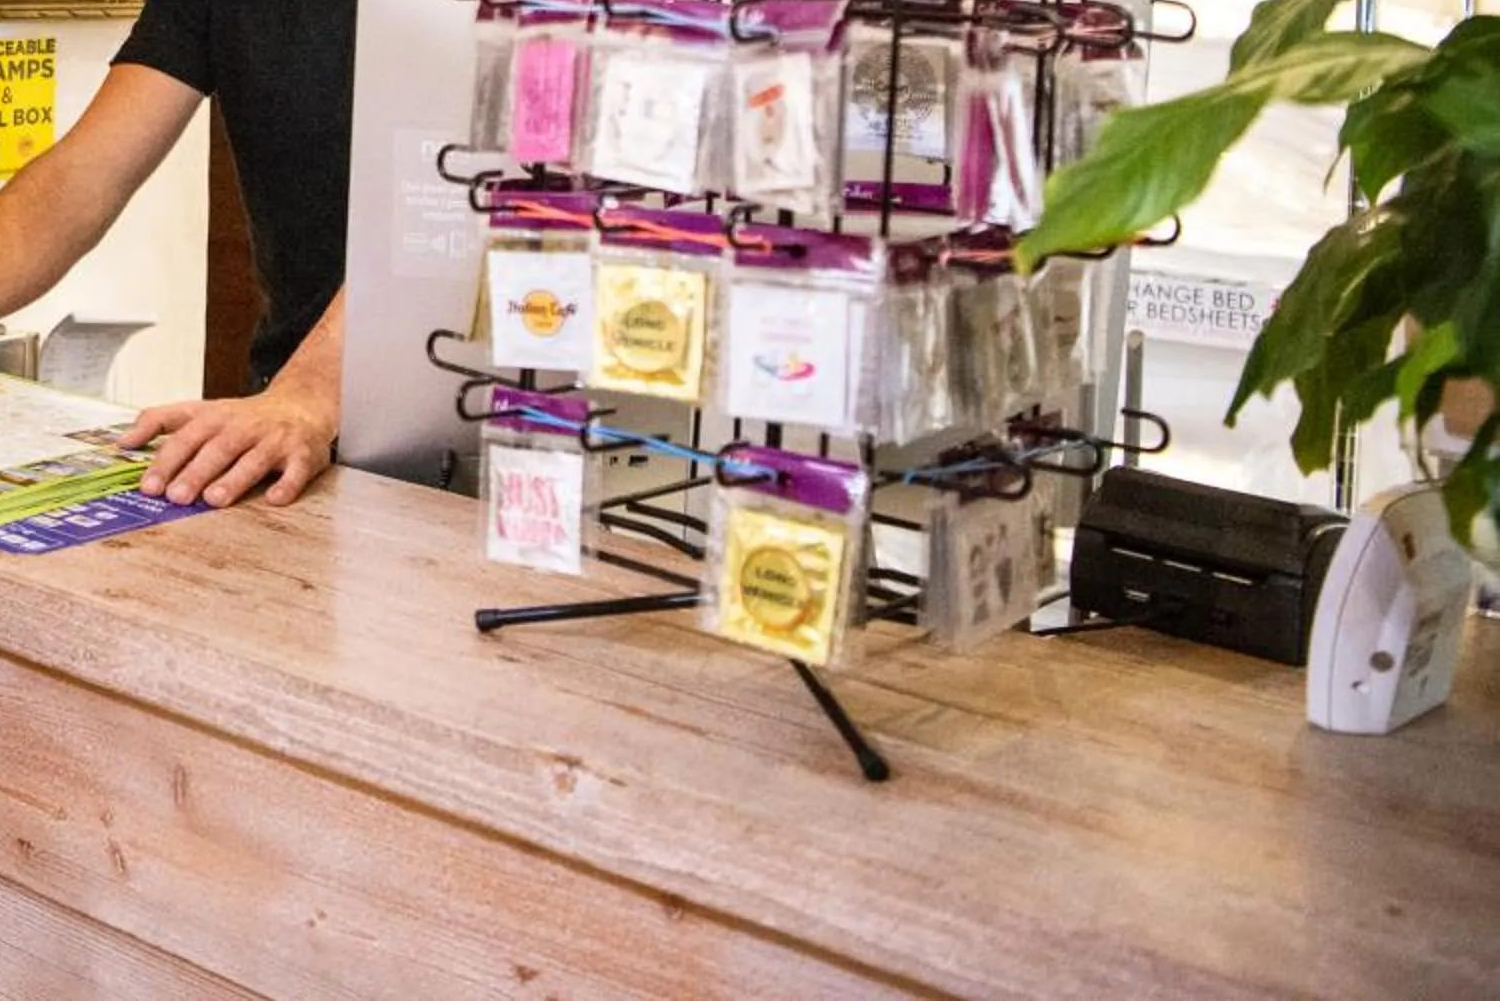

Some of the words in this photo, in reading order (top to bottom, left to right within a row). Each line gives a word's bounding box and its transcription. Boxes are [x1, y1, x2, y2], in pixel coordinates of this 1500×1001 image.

[1, 86, 13, 104] &
[13, 106, 53, 127] BOX
[1212, 290, 1256, 312] BED
[1146, 301, 1262, 333] BEDSHEETS
